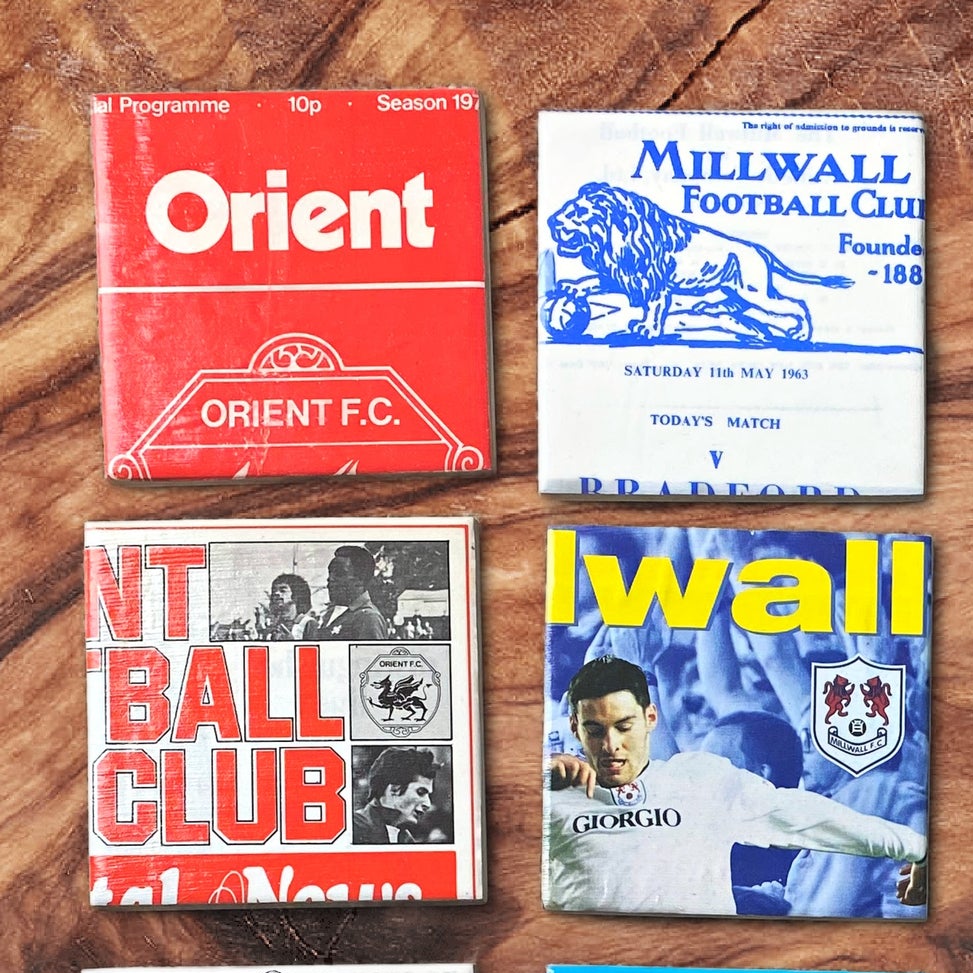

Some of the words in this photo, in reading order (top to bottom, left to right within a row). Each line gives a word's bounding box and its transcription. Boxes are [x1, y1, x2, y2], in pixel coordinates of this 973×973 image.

[120, 97, 230, 117] Programme
[288, 96, 322, 115] 10p
[377, 94, 447, 111] Season
[760, 122, 781, 131] right
[796, 123, 838, 131] admission
[852, 125, 886, 133] grounds
[889, 124, 896, 132] is
[630, 140, 911, 184] MILLWALL
[145, 169, 435, 254] Orient
[681, 185, 847, 217] FOOTBALL
[624, 365, 702, 378] SATURDAY
[709, 366, 734, 378] 11th
[740, 368, 773, 379] MAY
[782, 368, 809, 380] 1963
[201, 398, 332, 428] ORIENT
[342, 396, 401, 427] F.C.
[650, 414, 713, 427] TODAY'S
[727, 417, 781, 430] MATCH
[86, 644, 345, 743] BALL
[830, 736, 868, 753] MILLWALL
[93, 747, 347, 846] CLUB
[572, 808, 681, 834] GIORGIO
